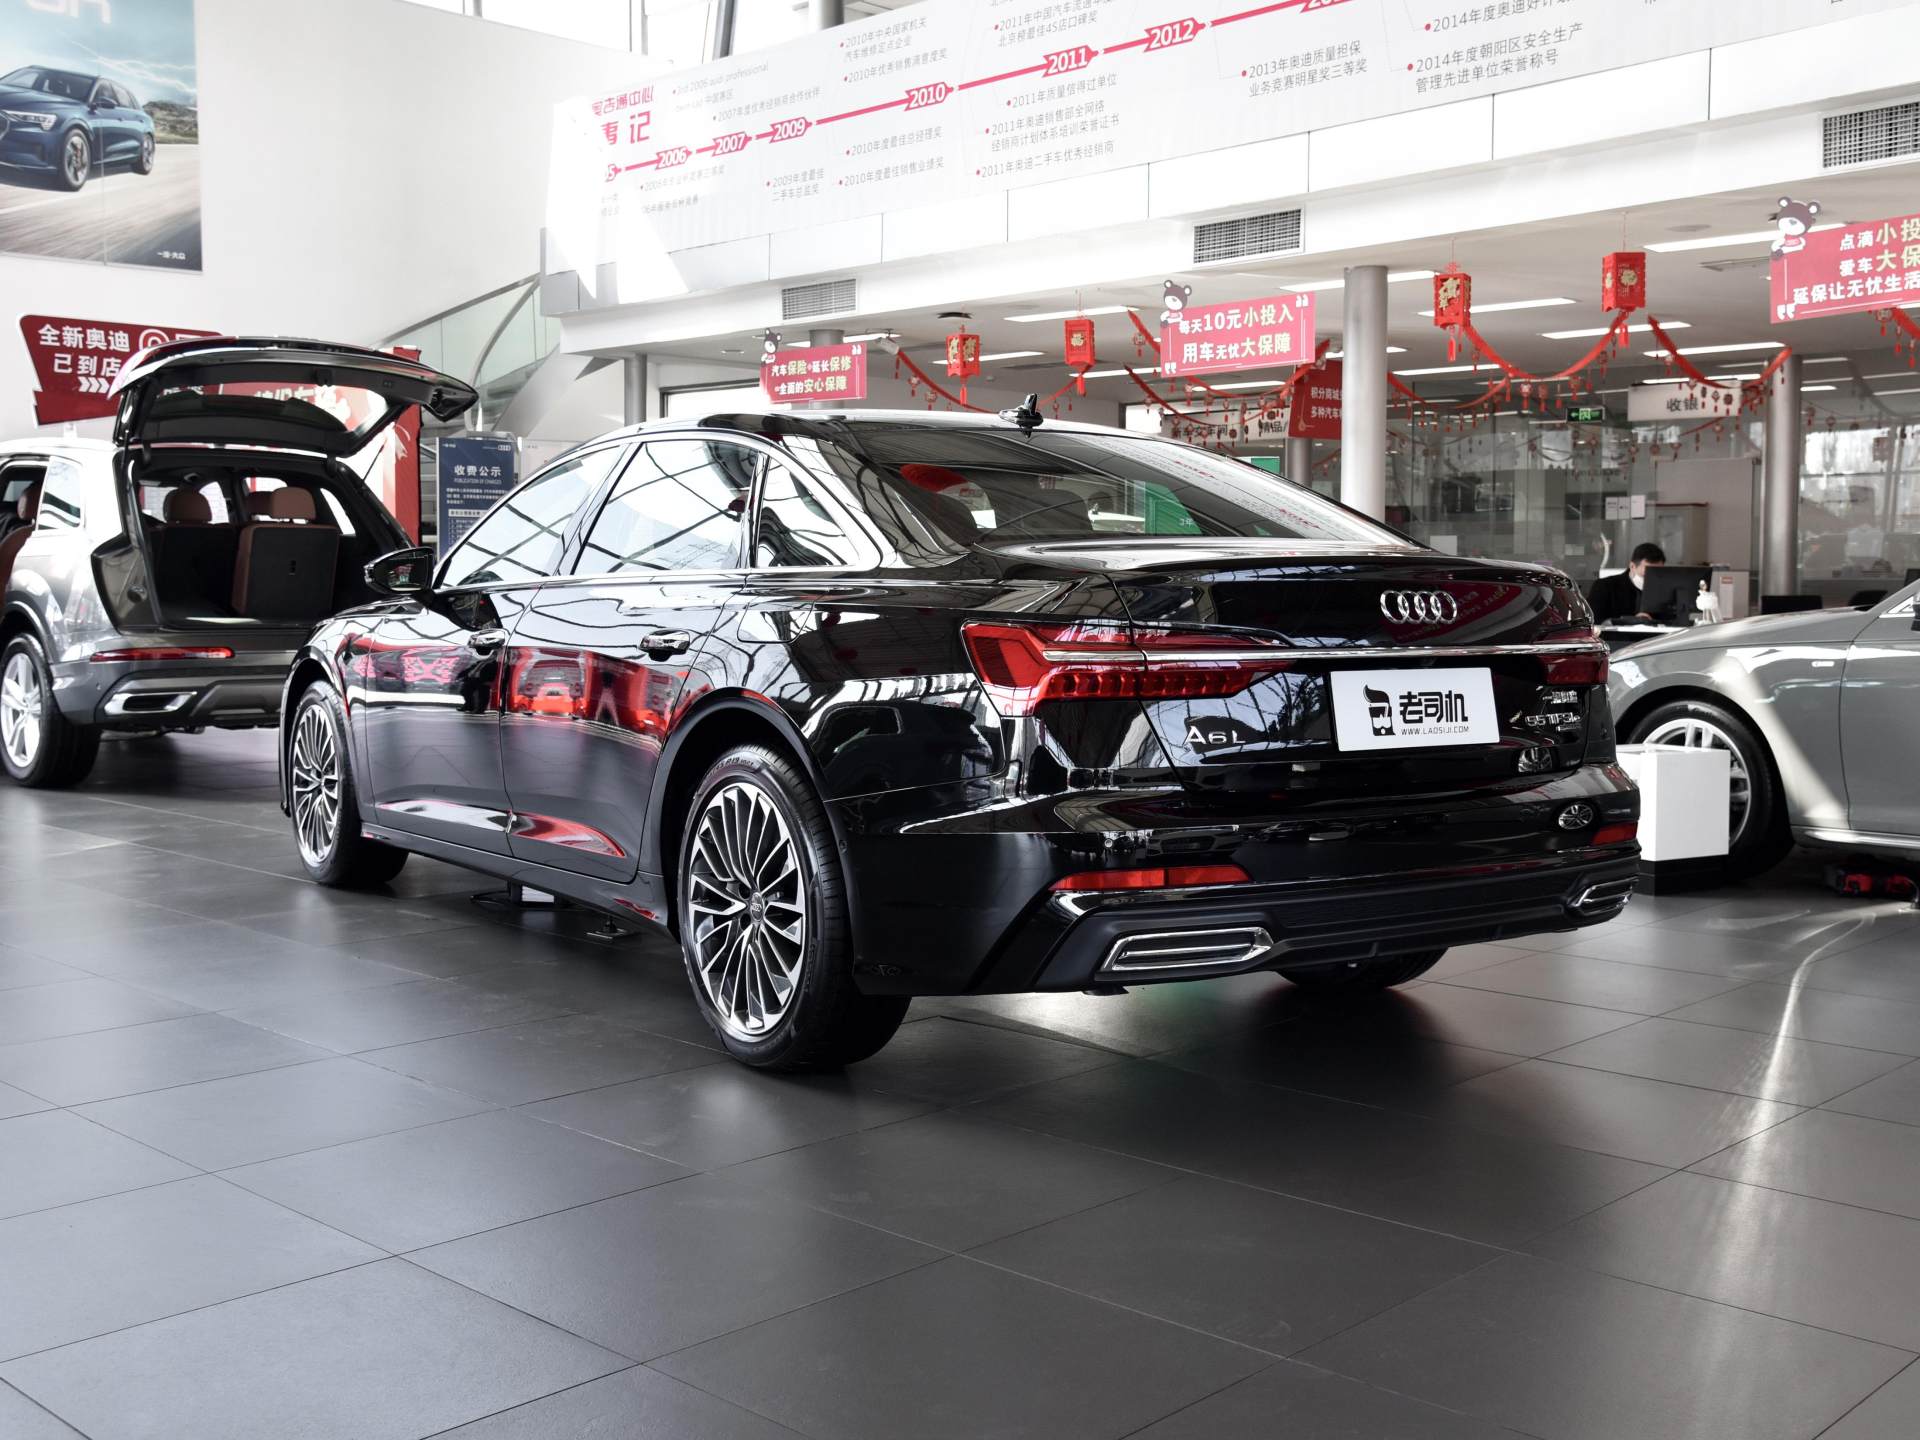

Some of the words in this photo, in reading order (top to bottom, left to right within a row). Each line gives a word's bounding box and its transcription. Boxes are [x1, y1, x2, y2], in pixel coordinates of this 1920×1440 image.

[1150, 20, 1195, 50] 2012
[1416, 22, 1583, 73] 2014年度朝阳区安全生产
[1047, 48, 1088, 75] 2011
[1248, 40, 1361, 79] 2013年奥迪质量担保
[1415, 48, 1559, 94] 管理先进单位荣誉称号
[1248, 58, 1368, 98] 业务竞赛明星奖三等奖
[908, 84, 945, 108] 2010
[714, 134, 746, 155] 2007
[774, 119, 806, 141] 2009
[658, 148, 687, 168] 2006
[1178, 303, 1294, 335] 每天10元小投入
[37, 323, 131, 353] 全新奥迪
[1182, 332, 1292, 364] 用车无忧大保障
[454, 464, 502, 478] 收费公示
[1399, 690, 1469, 724] 老司机
[1401, 725, 1470, 737] WWW.LAOSIJI.COM
